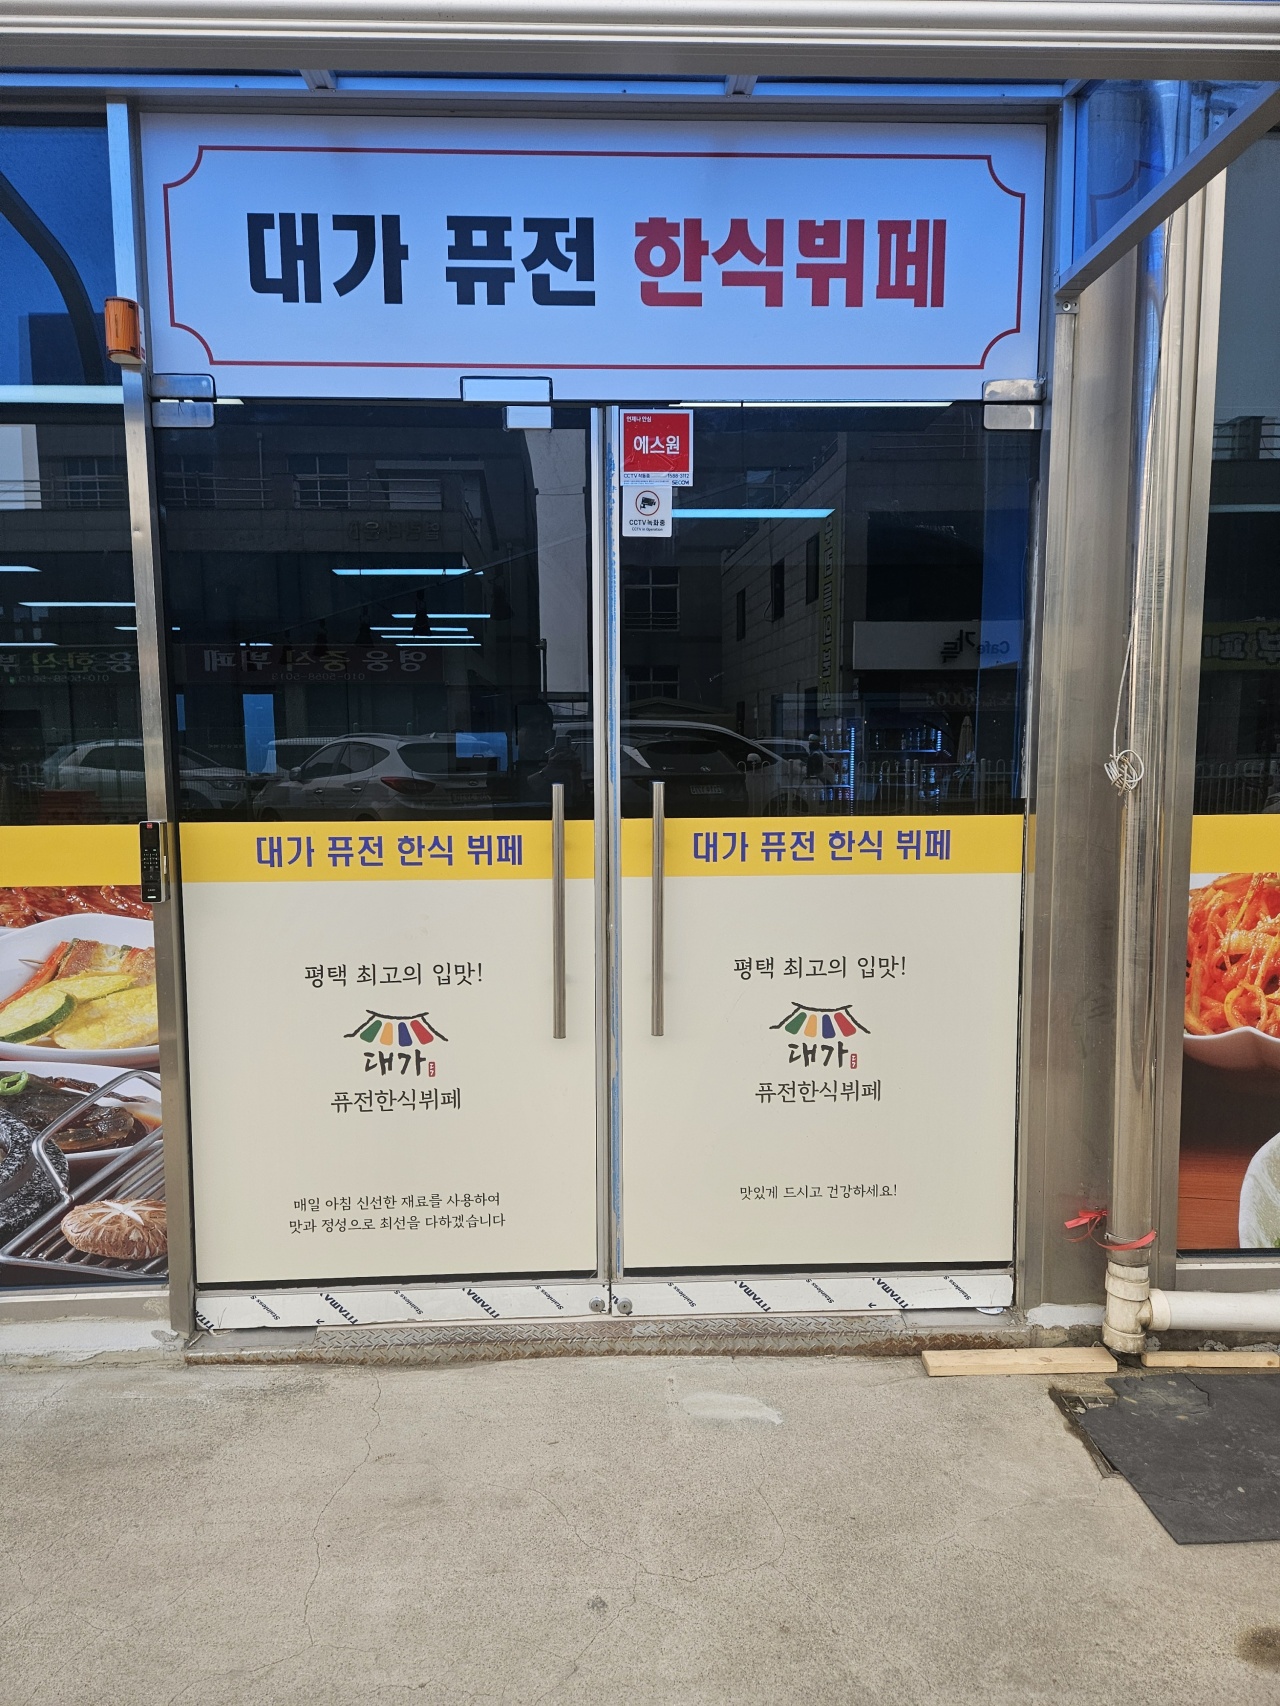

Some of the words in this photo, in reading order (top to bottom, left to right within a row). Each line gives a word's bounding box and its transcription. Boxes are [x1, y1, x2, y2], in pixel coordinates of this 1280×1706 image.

[246, 212, 409, 305] 대가
[445, 215, 596, 307] 퓨전
[633, 216, 947, 308] 한식뷔페
[633, 435, 680, 455] 에스원
[256, 836, 315, 868] 대가
[327, 835, 384, 867] 퓨전
[397, 835, 453, 867] 한식
[467, 835, 523, 866] 뷔페
[693, 831, 749, 863] 대가
[761, 830, 815, 862] 퓨전
[828, 830, 883, 861] 한식
[896, 830, 951, 860] 뷔페
[304, 963, 347, 989] 평택
[356, 962, 422, 986] 최고의
[432, 961, 483, 987] 입맛!
[733, 956, 774, 981] 평택
[783, 955, 847, 979] 최고의
[857, 955, 906, 980] 입맛!
[363, 1048, 427, 1077] 대가
[787, 1040, 849, 1068] 대가
[330, 1087, 461, 1114] 퓨전한식뷔페
[755, 1079, 882, 1104] 퓨전한식뷔페
[293, 1196, 320, 1212] 매일
[325, 1196, 352, 1212] 아침
[356, 1195, 398, 1211] 신선한
[401, 1193, 443, 1209] 재료를
[446, 1191, 500, 1208] 사용하여
[739, 1185, 778, 1201] 맛있게
[783, 1184, 823, 1199] 드시고
[827, 1183, 898, 1199] 건강하세요!
[289, 1218, 317, 1235] 맛과
[321, 1217, 376, 1234] 정성으로
[379, 1215, 421, 1231] 최선을
[425, 1213, 506, 1230] 다하겠습니다
[540, 1288, 564, 1310] Stainless
[673, 1286, 697, 1308] Stainless
[812, 1282, 835, 1304] Stainless
[949, 1279, 972, 1301] Stainless
[256, 1298, 281, 1320] Stainless
[399, 1293, 424, 1315] Stainless
